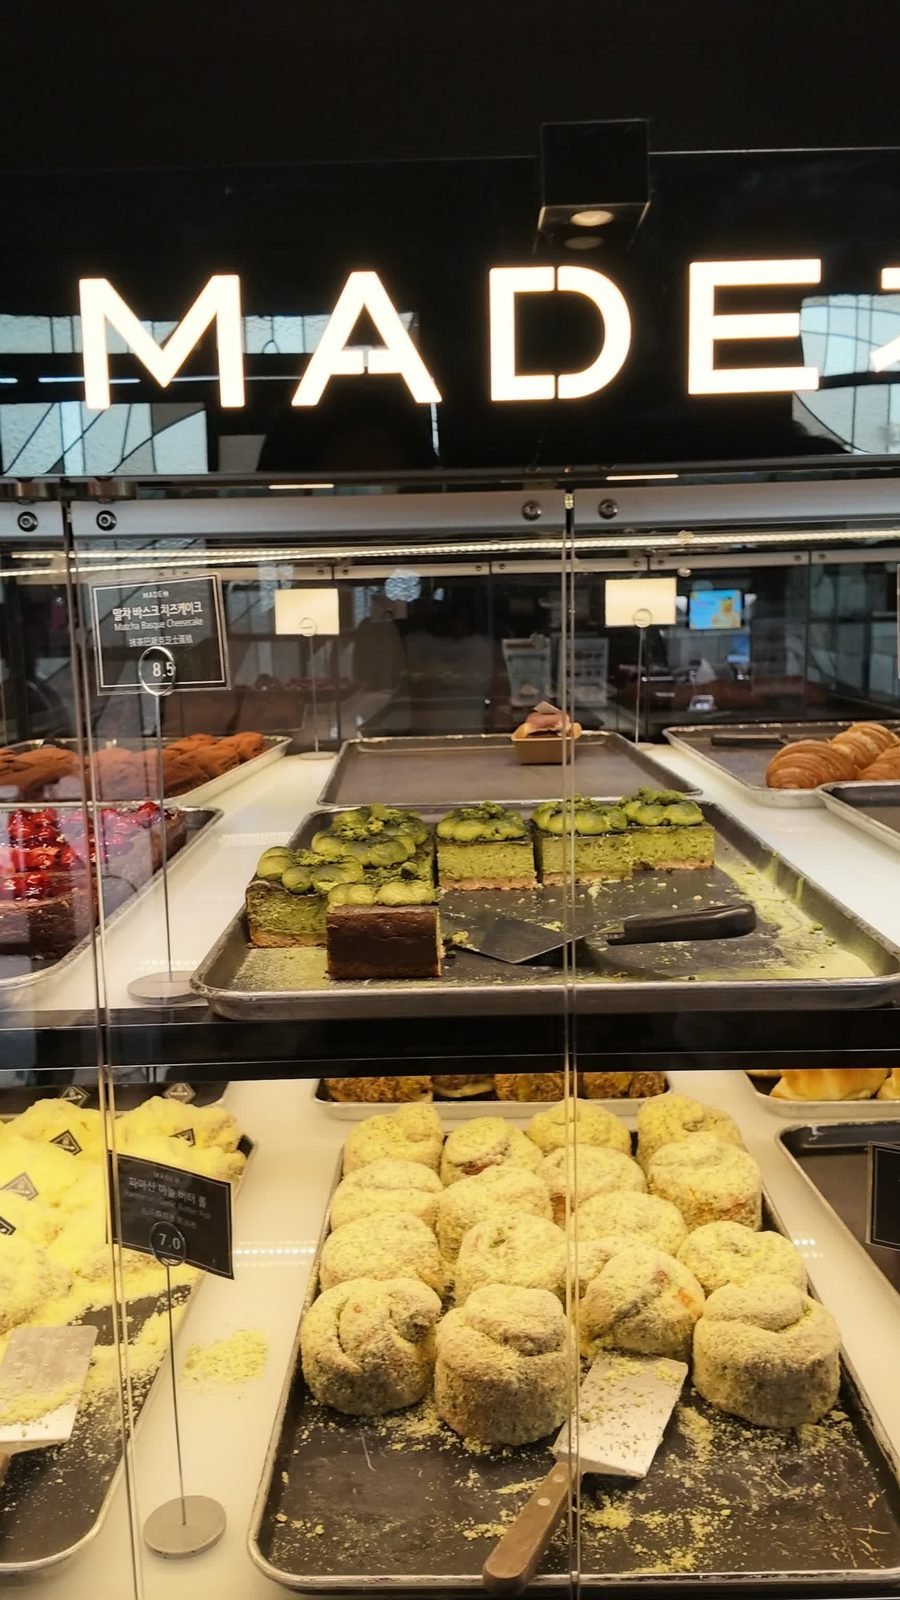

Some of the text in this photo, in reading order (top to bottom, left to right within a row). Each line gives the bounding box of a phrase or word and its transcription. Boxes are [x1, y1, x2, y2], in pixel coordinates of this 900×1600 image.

[78, 258, 900, 410] MADE
[112, 601, 203, 621] 말차 바스크 치즈케이크
[114, 618, 204, 631] Matcha Basque Cheesecake
[152, 662, 175, 677] 8.5
[178, 1191, 196, 1205] 버터
[159, 1233, 181, 1250] 7.0
